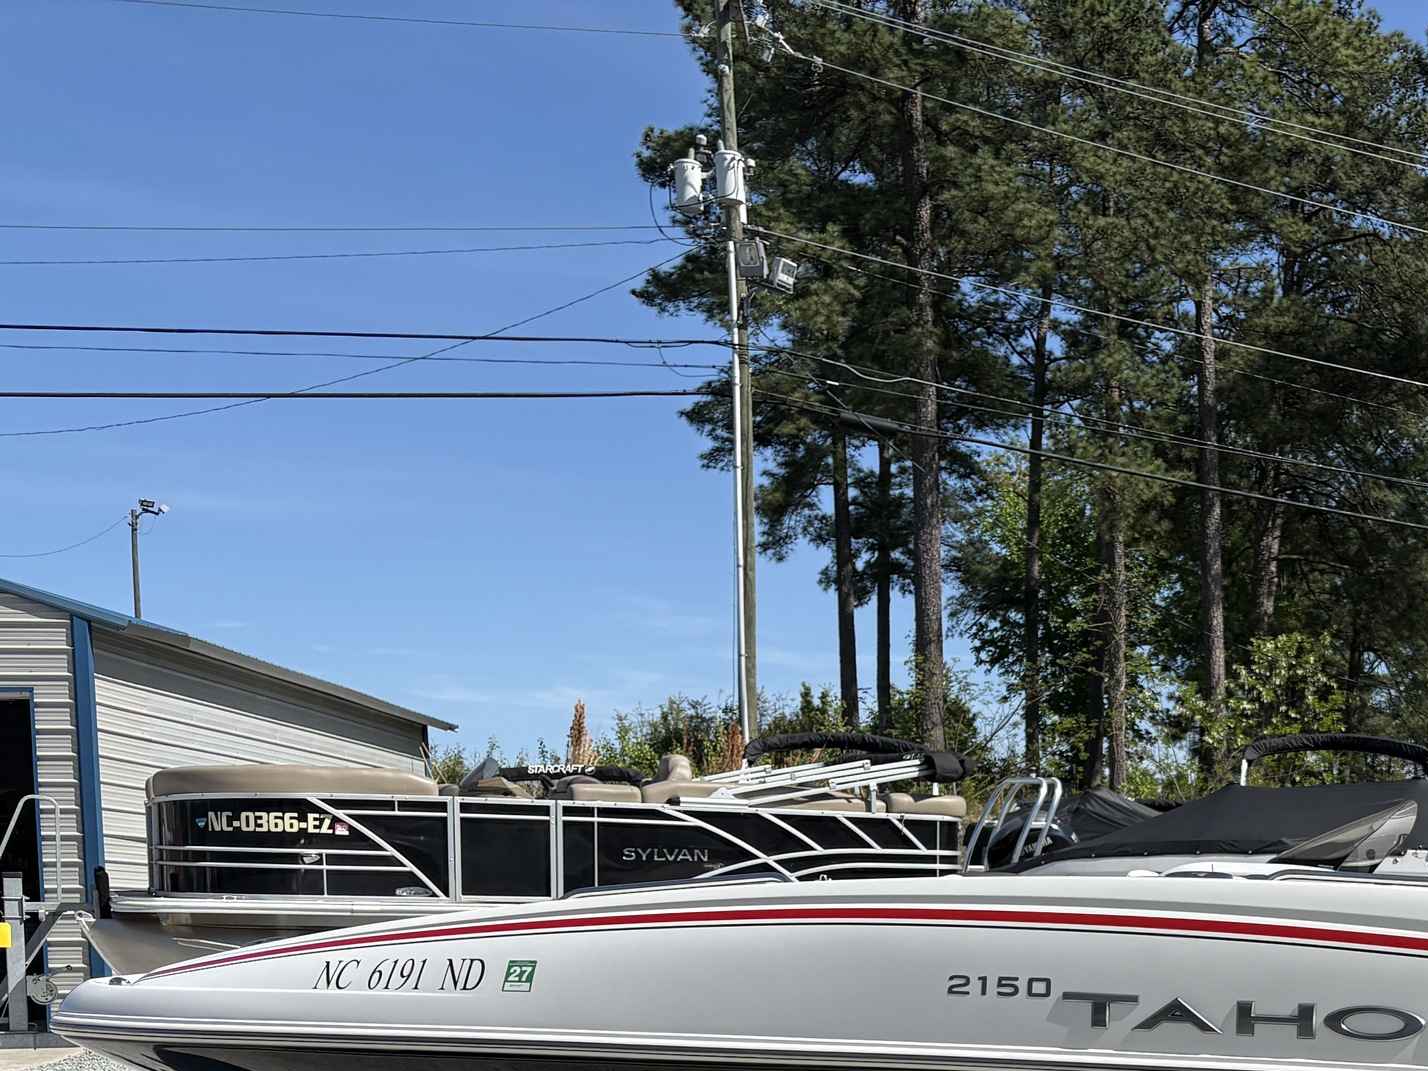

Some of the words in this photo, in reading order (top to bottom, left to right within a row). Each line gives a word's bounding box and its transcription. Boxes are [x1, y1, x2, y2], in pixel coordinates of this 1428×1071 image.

[528, 764, 584, 774] STARCRAFT
[622, 847, 709, 862] SYLVAN
[312, 959, 361, 990] NC
[367, 958, 428, 990] 6191
[438, 958, 486, 991] ND
[507, 966, 533, 981] 27
[946, 974, 1053, 999] 2150
